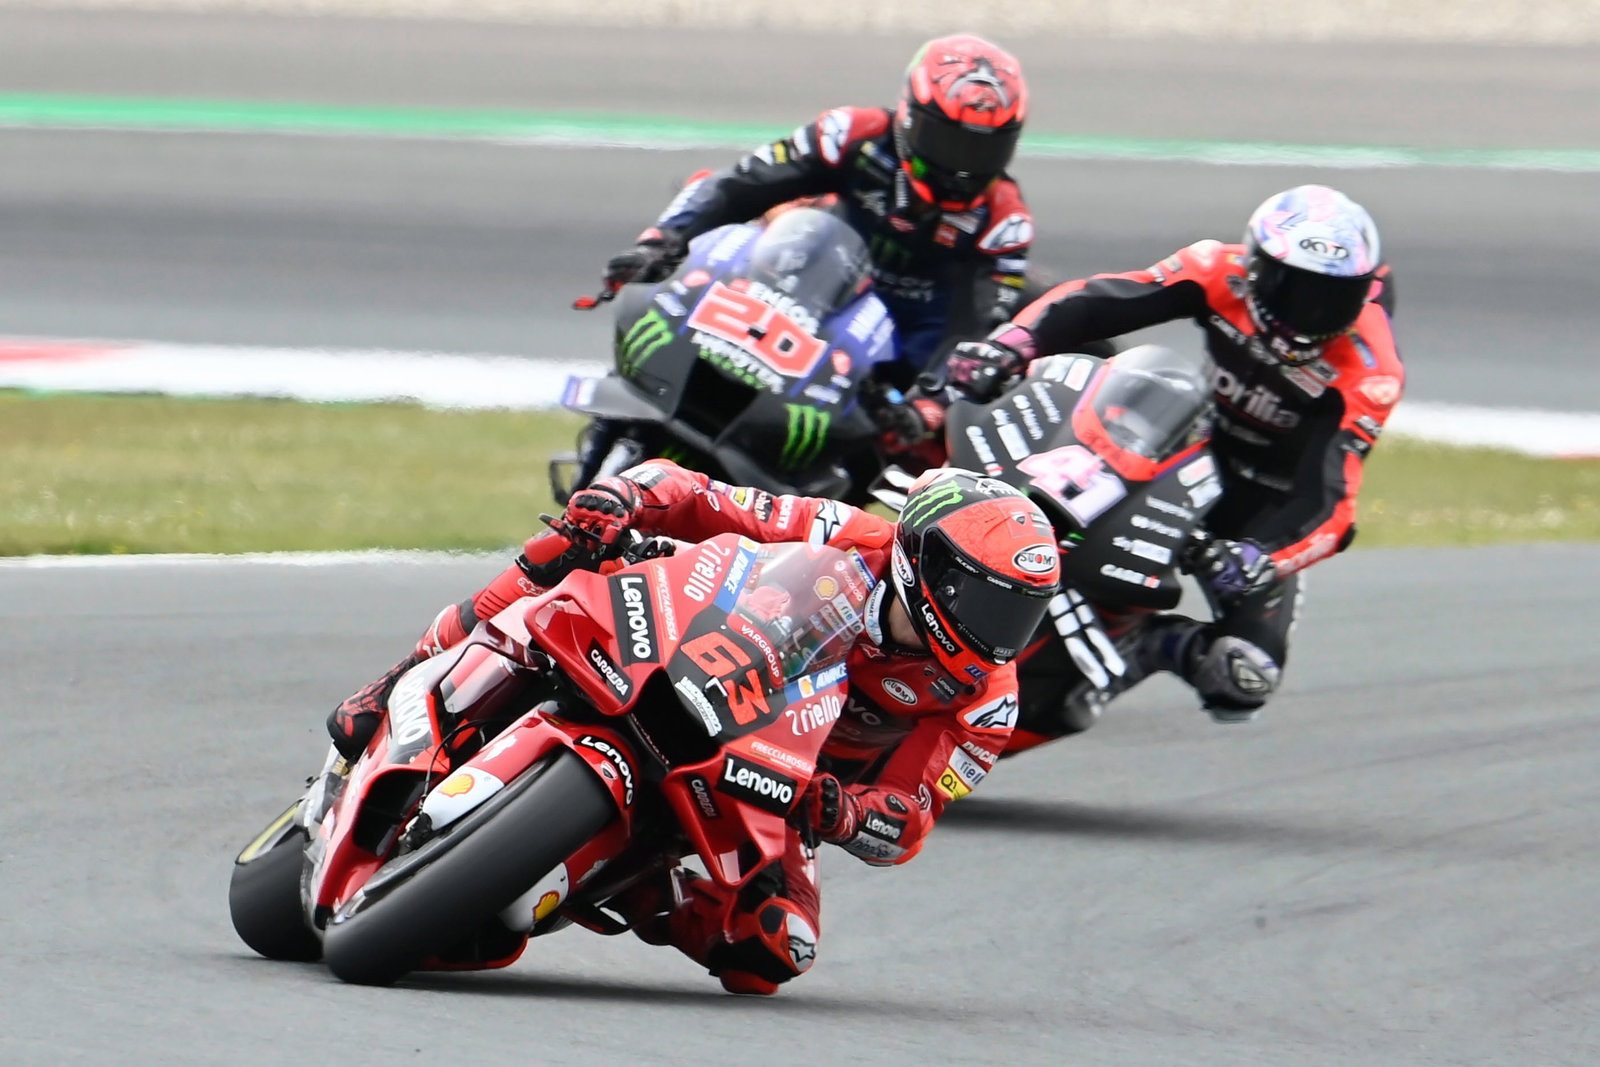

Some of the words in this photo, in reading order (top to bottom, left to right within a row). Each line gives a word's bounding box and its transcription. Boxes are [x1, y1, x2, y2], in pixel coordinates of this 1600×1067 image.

[686, 280, 830, 378] 20
[621, 577, 652, 659] Lenovo
[921, 603, 955, 653] Lenovo
[590, 648, 627, 696] CARRERA
[741, 625, 779, 678] VARGROUP
[680, 632, 770, 725] 63
[885, 679, 915, 704] SUOMY
[937, 676, 955, 696] Lenovo
[580, 736, 634, 805] Lenovo
[724, 759, 792, 803] Lenovo
[751, 741, 816, 773] FRECCIAROSSA
[960, 761, 985, 785] riell
[865, 814, 900, 839] Lenovo
